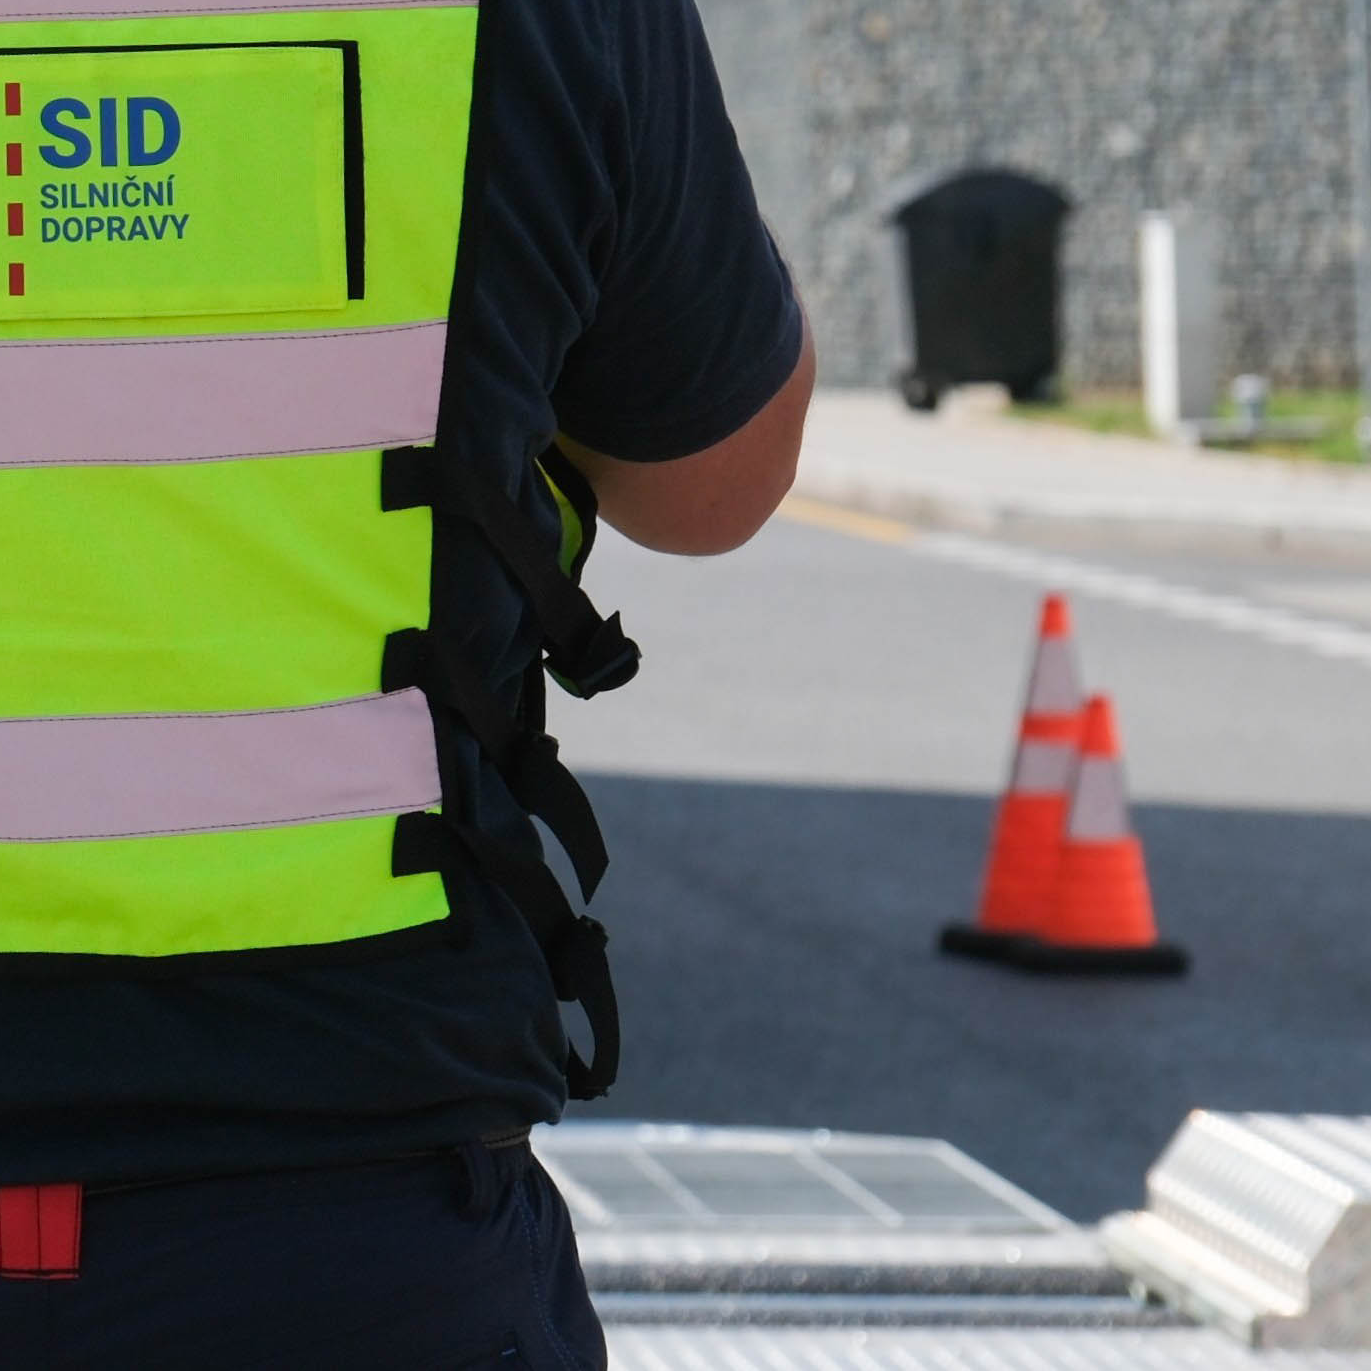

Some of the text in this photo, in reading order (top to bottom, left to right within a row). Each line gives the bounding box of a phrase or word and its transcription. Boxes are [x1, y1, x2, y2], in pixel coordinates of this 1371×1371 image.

[38, 96, 181, 170] SID
[40, 174, 175, 210] SILNIČNÍ
[41, 213, 190, 243] DOPRAVY
